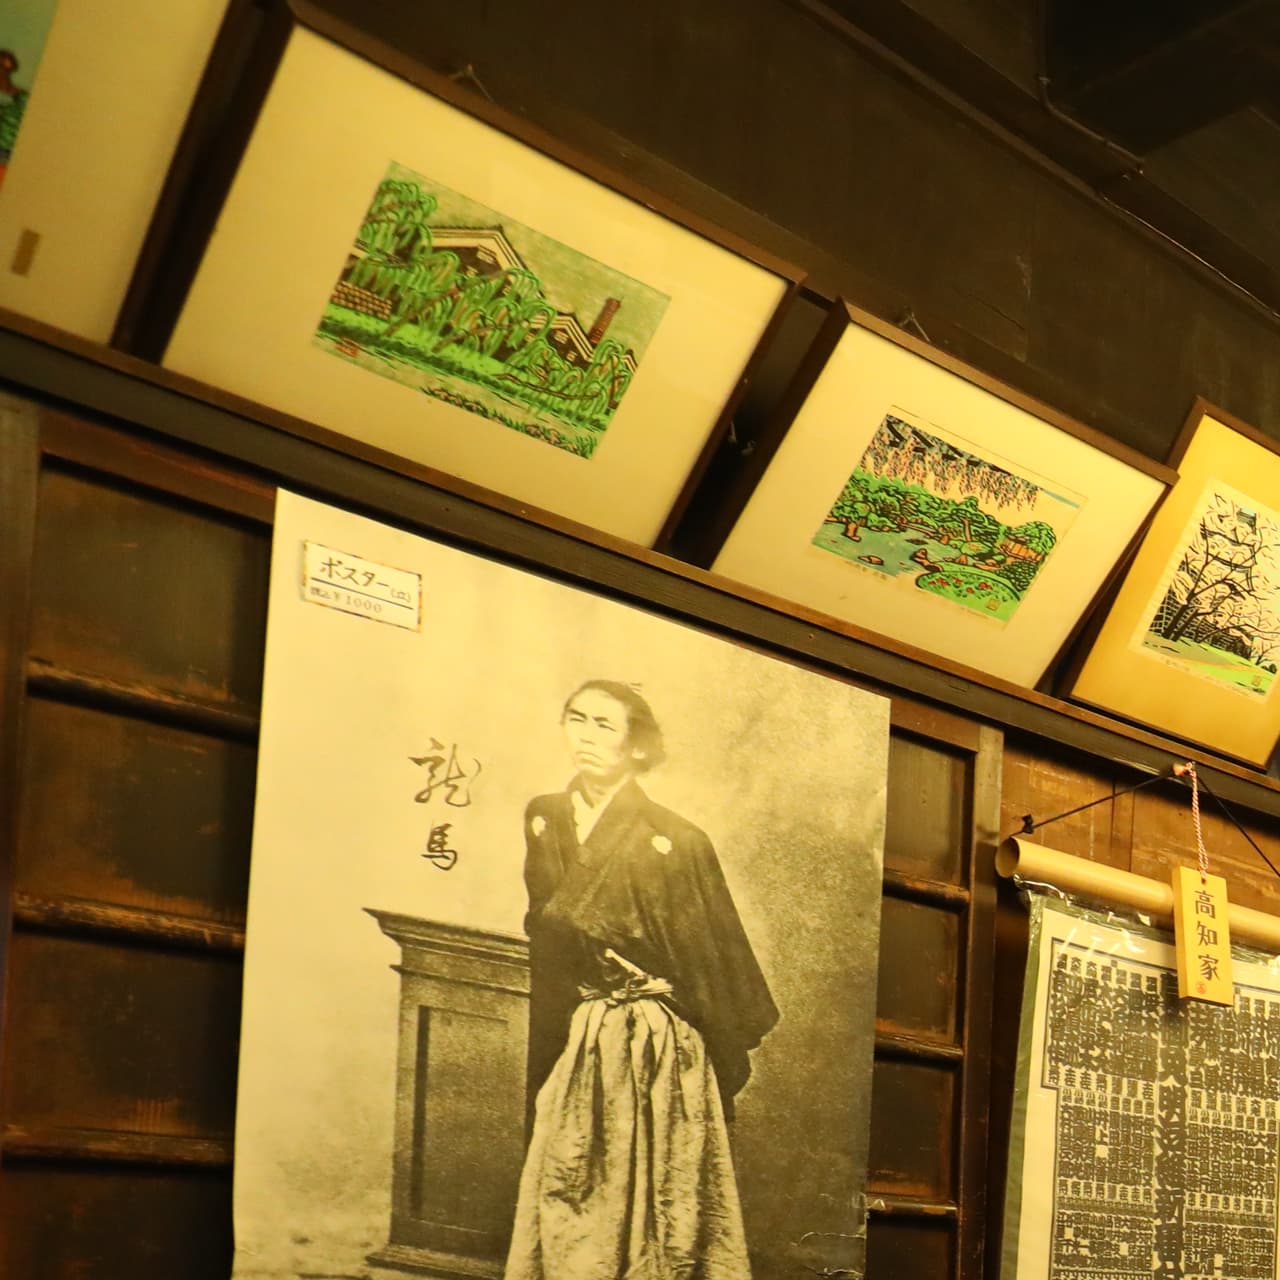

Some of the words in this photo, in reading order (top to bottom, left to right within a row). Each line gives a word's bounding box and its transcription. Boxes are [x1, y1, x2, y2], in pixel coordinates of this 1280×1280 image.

[319, 556, 390, 587] ポスター
[1193, 889, 1221, 982] 高知家
